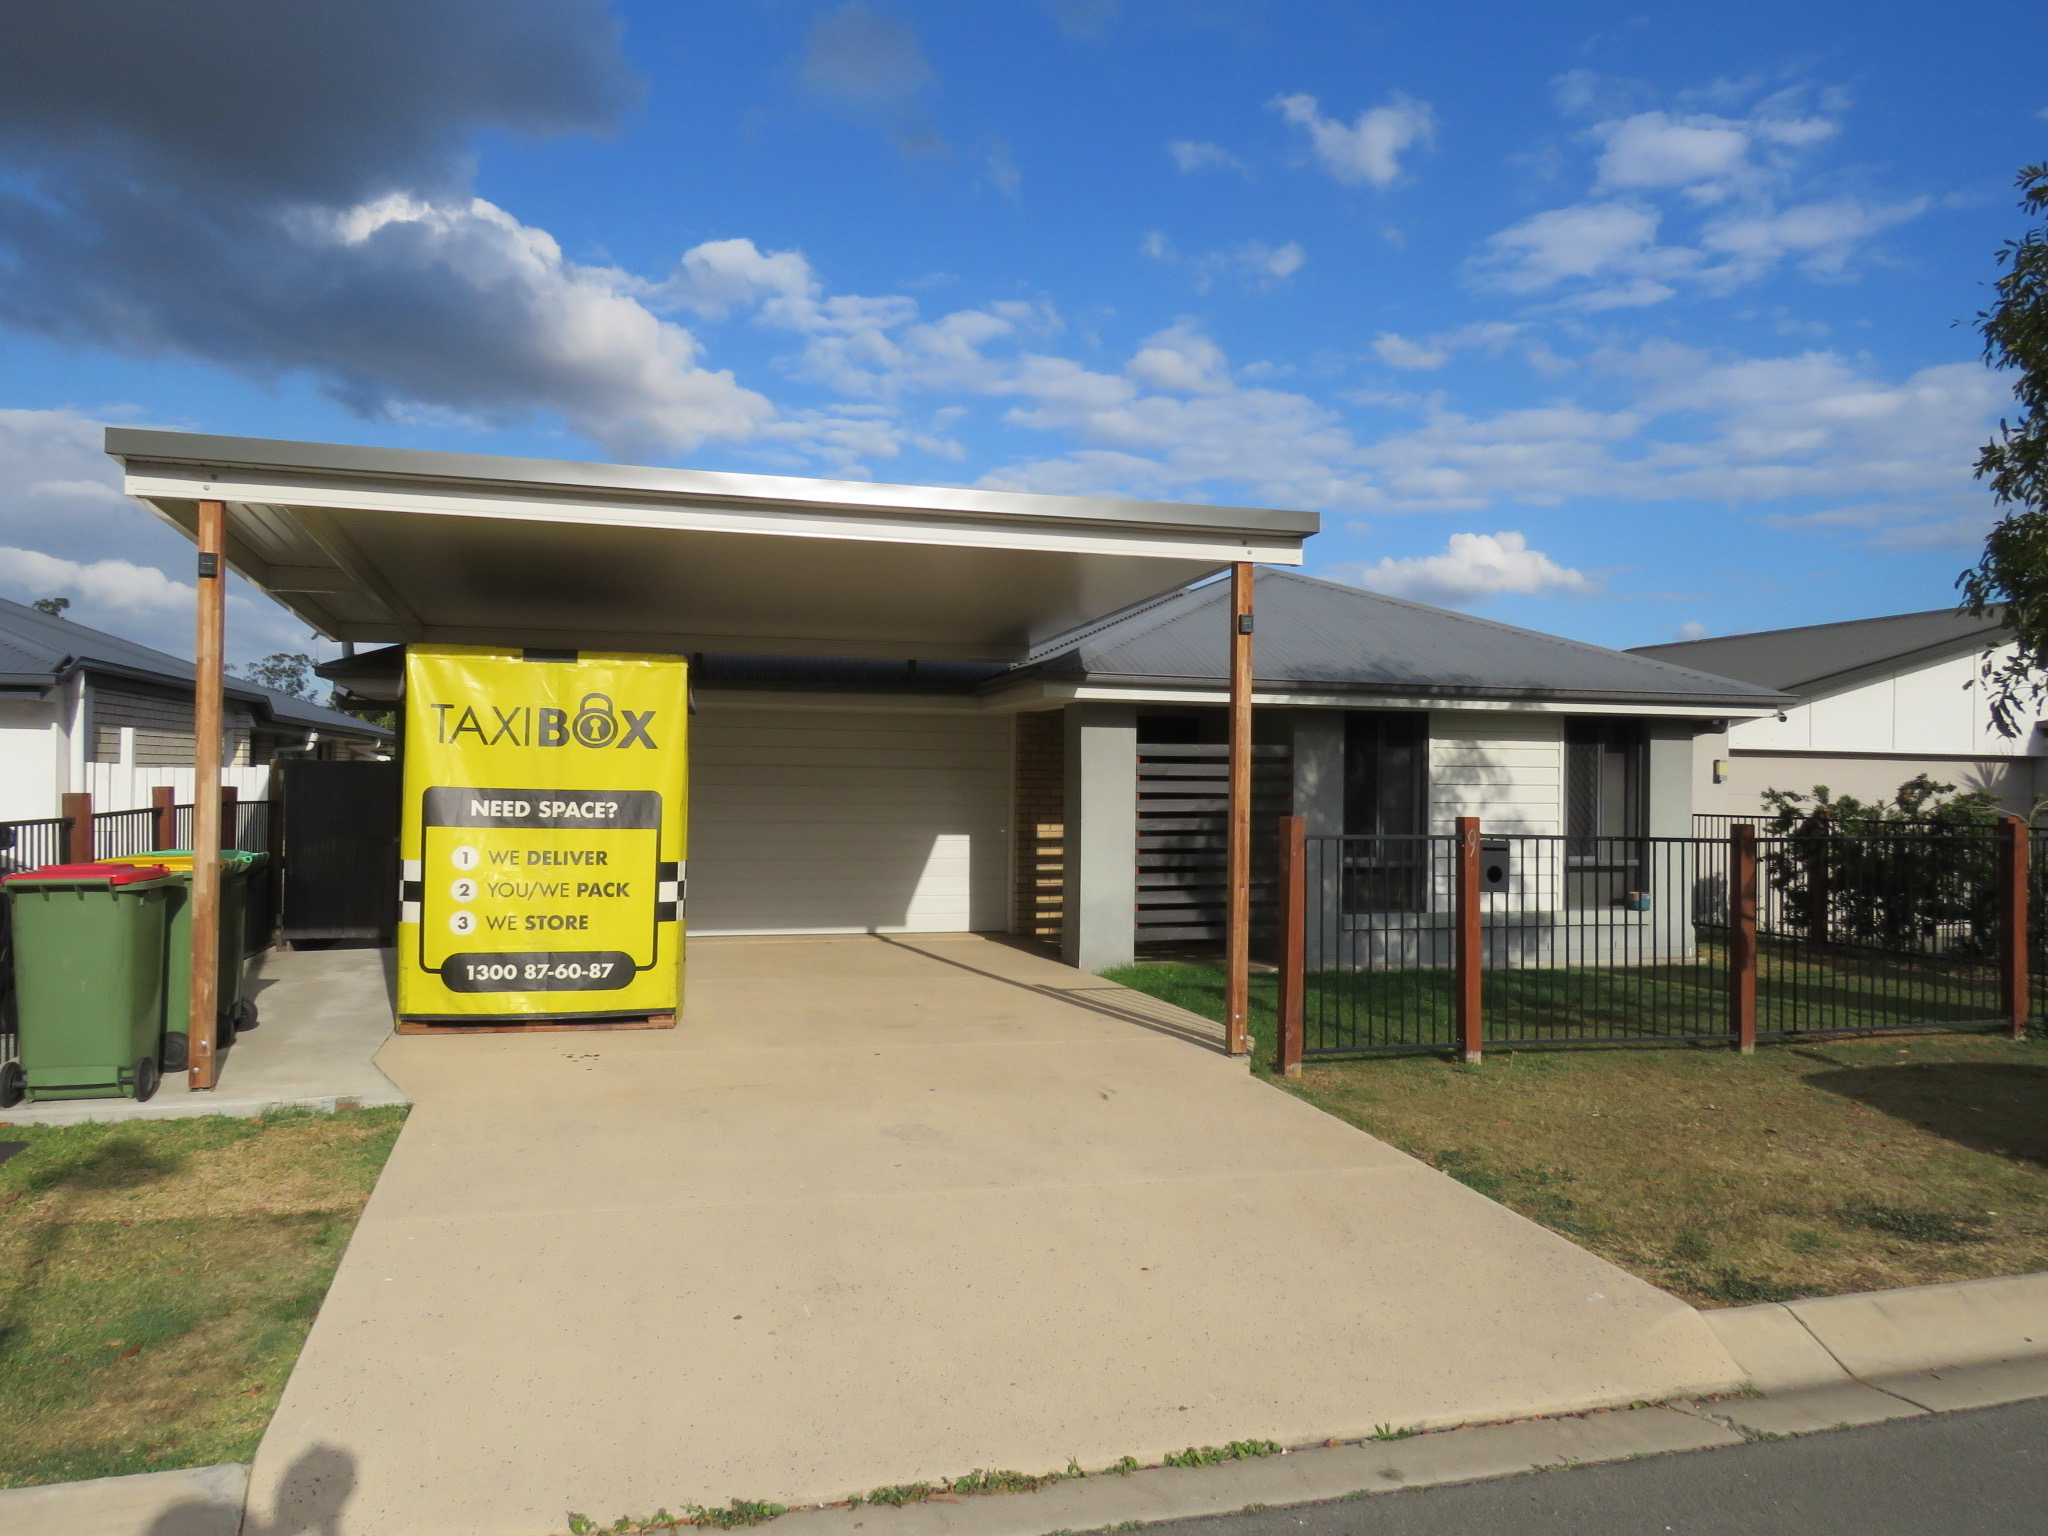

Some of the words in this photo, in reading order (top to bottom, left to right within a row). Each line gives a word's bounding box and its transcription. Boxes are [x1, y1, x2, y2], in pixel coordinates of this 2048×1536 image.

[430, 693, 659, 750] TAXIBOX
[470, 799, 531, 818] NEED
[538, 800, 619, 819] SPACE?
[461, 851, 470, 865] 1
[488, 851, 520, 866] WE
[526, 850, 608, 866] DELIVER
[457, 884, 470, 898] 2
[487, 882, 570, 900] YOU/WE
[576, 882, 630, 898] PACK
[456, 916, 470, 931] 3
[486, 915, 518, 931] WE
[524, 915, 589, 931] STORE
[465, 962, 518, 981] 1300
[523, 963, 614, 980] 87-60-87
